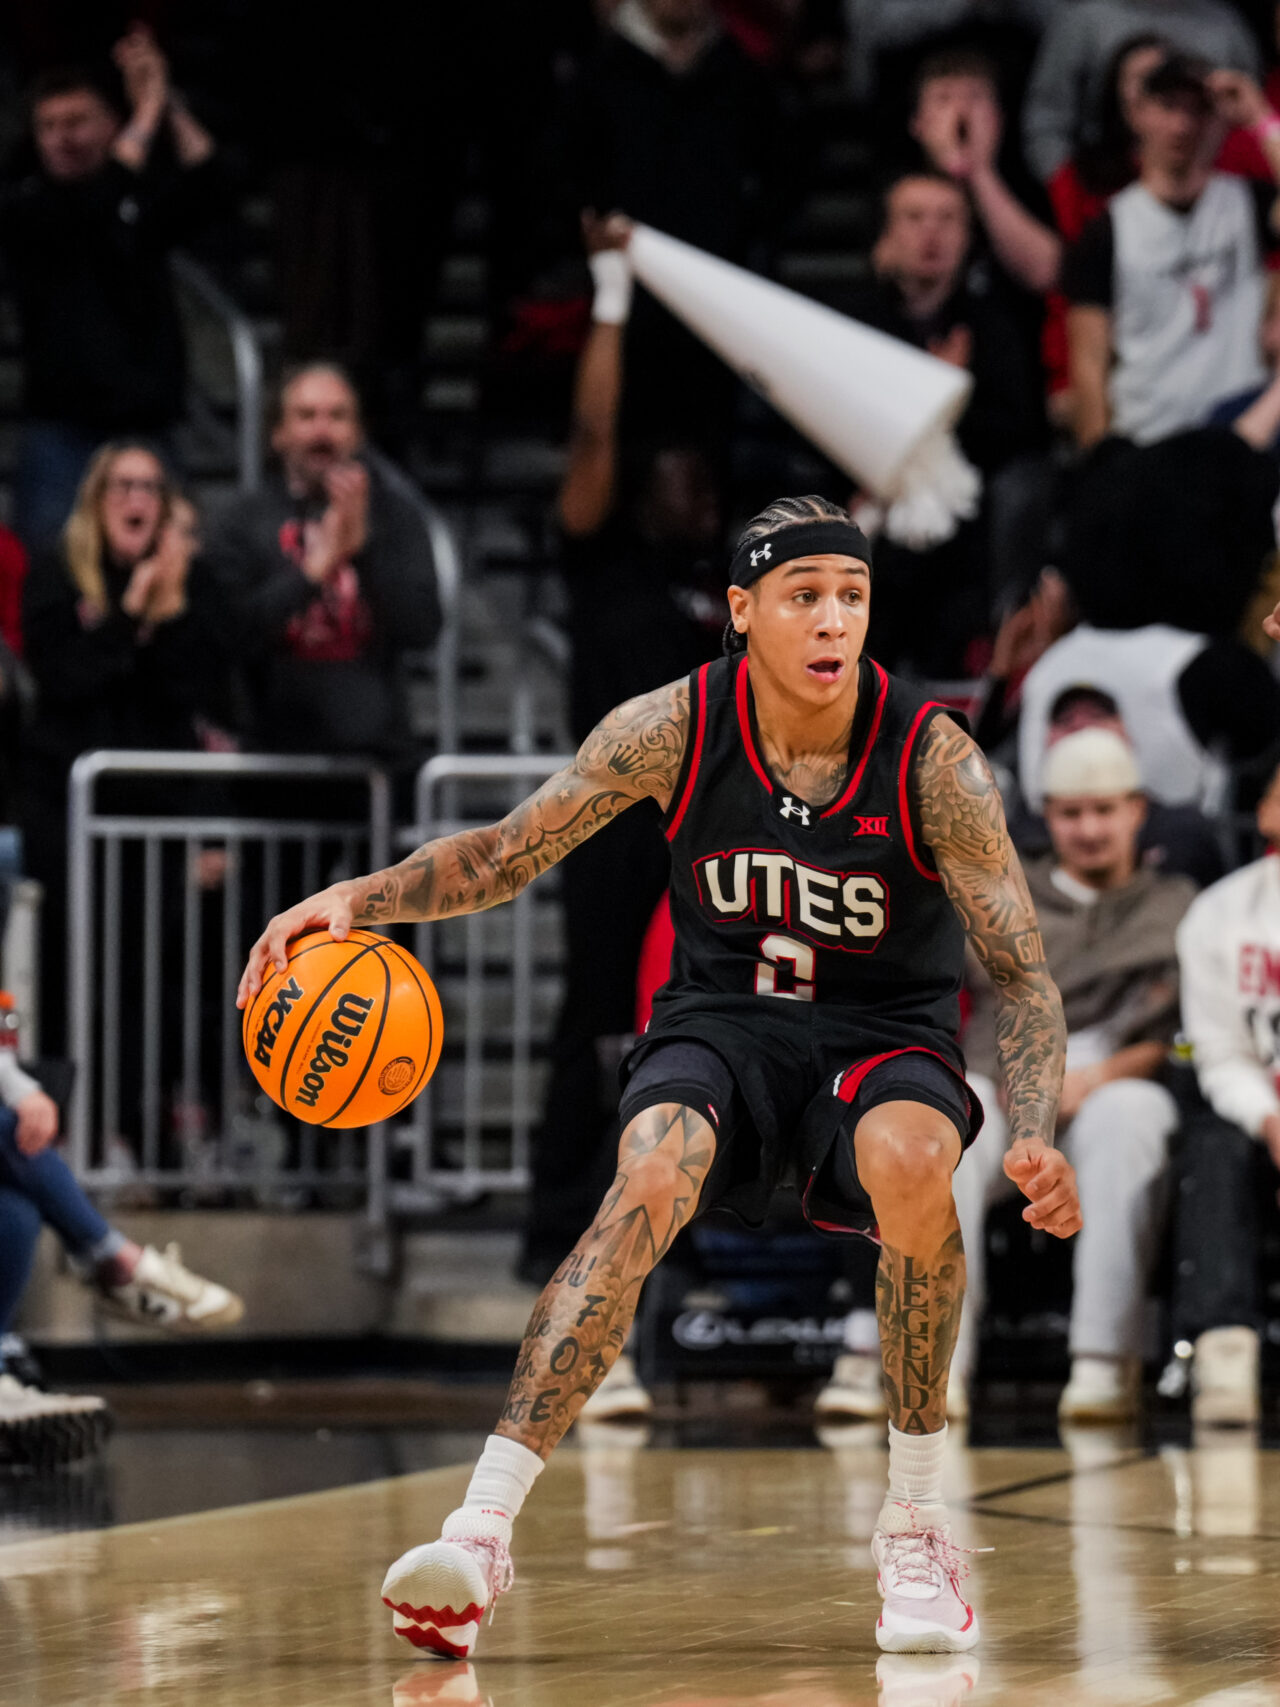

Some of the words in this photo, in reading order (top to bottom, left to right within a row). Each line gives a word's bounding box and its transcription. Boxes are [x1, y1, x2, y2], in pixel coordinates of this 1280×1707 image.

[853, 816, 890, 837] XII
[705, 853, 885, 937] UTES
[755, 933, 817, 1002] 2
[254, 976, 304, 1069] NCAA
[295, 992, 376, 1107] Wilson
